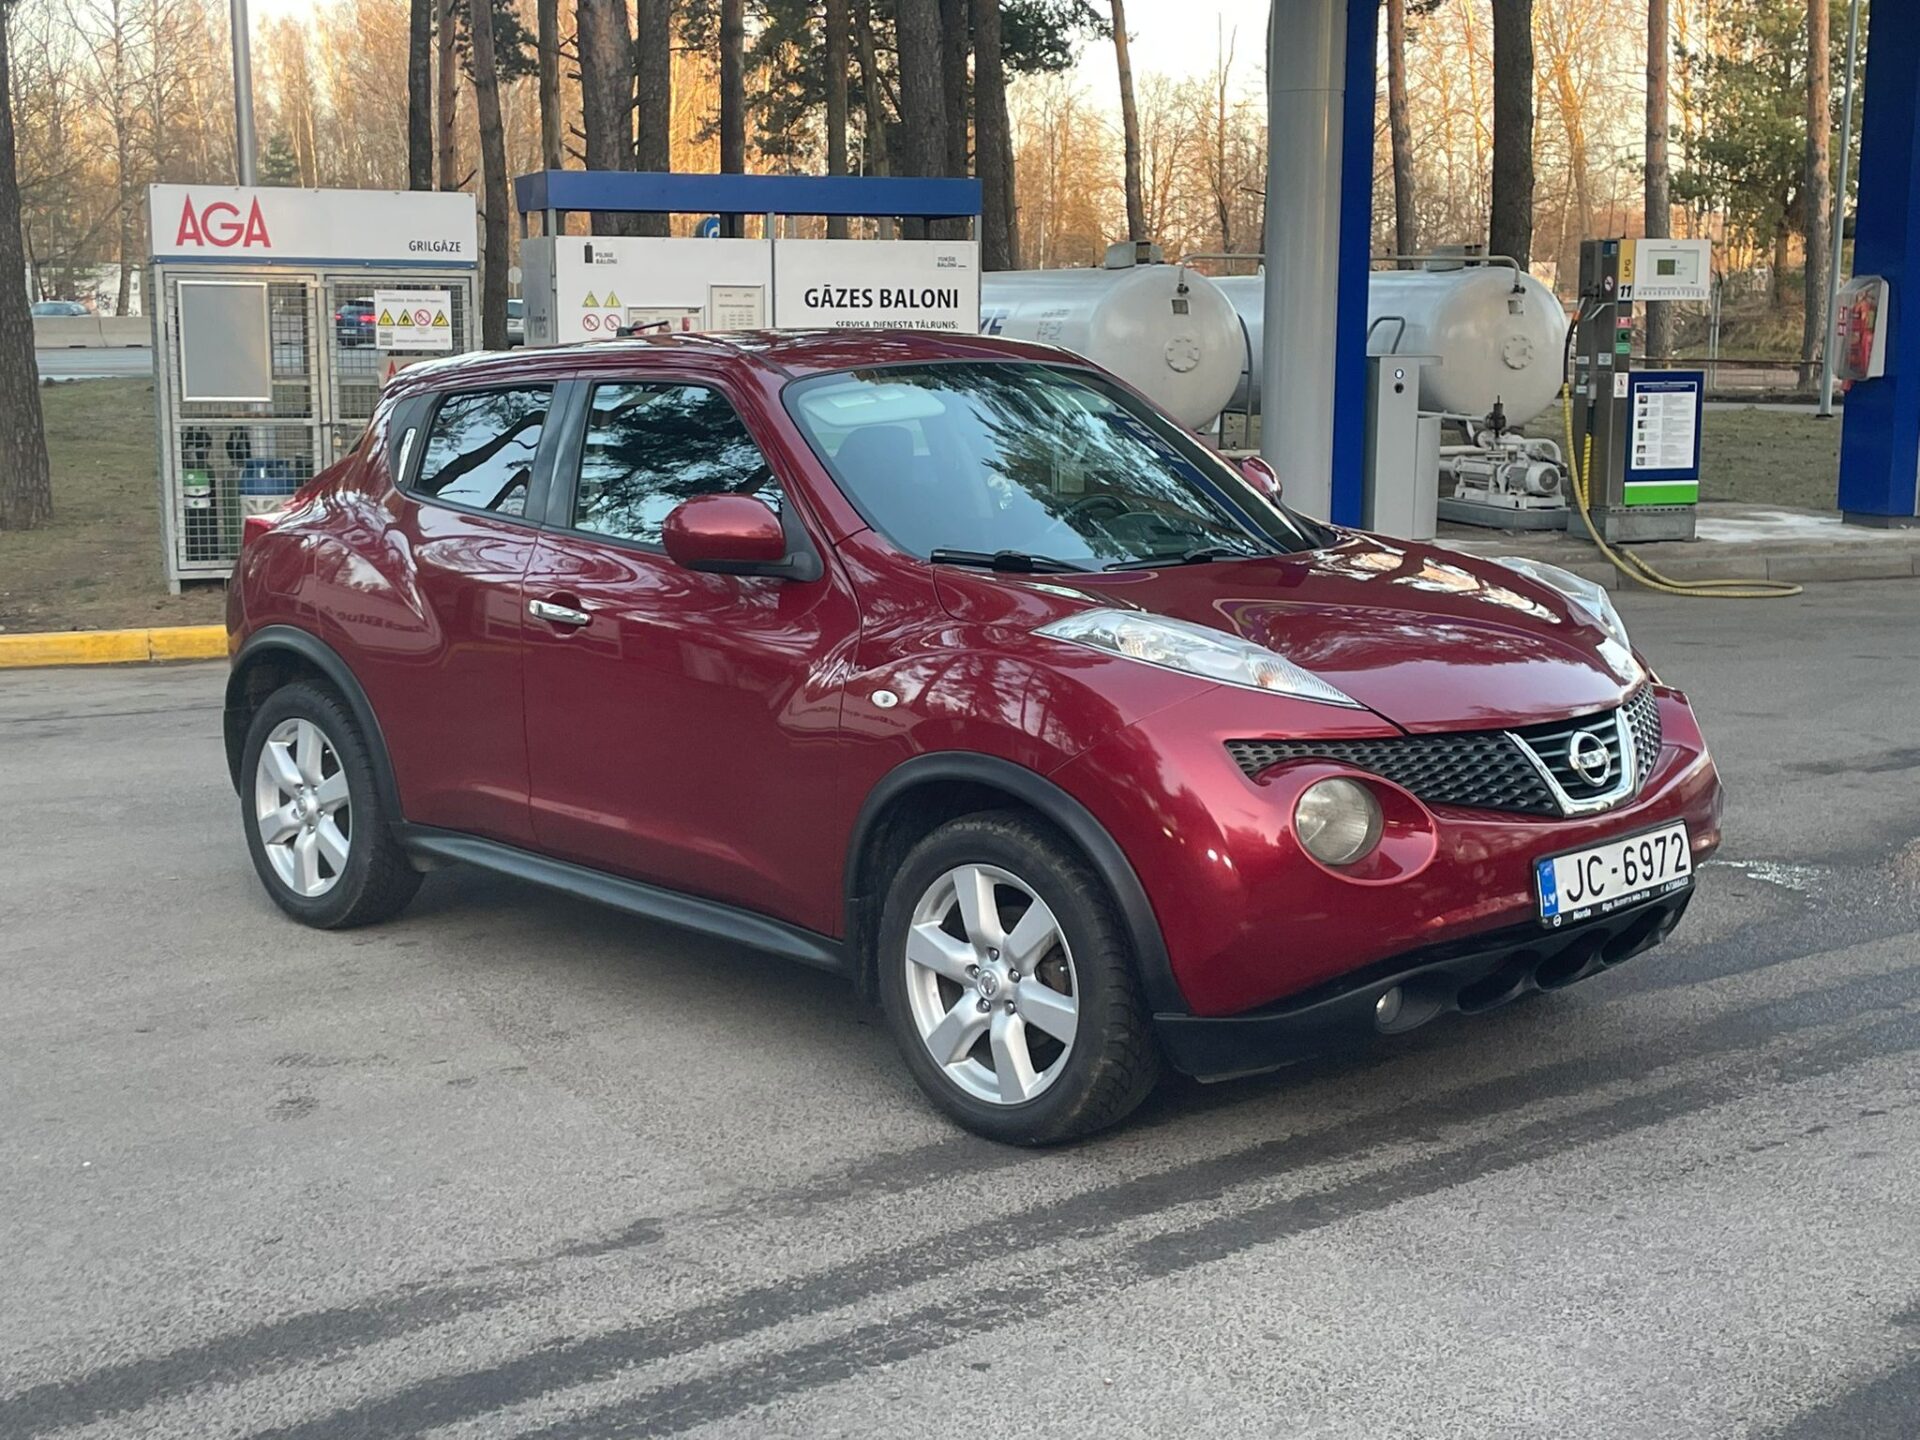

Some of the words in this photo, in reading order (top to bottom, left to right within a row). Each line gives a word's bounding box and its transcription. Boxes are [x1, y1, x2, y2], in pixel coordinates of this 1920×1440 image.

[176, 193, 272, 248] AGA
[408, 240, 462, 253] GRILGĀZE
[804, 284, 873, 308] GĀZES
[879, 288, 959, 309] BALONI
[1619, 284, 1632, 298] 11
[835, 320, 870, 328] SERVISA
[873, 320, 914, 329] DIENESTA
[1566, 832, 1687, 902] JC-6972
[1543, 892, 1556, 907] LV
